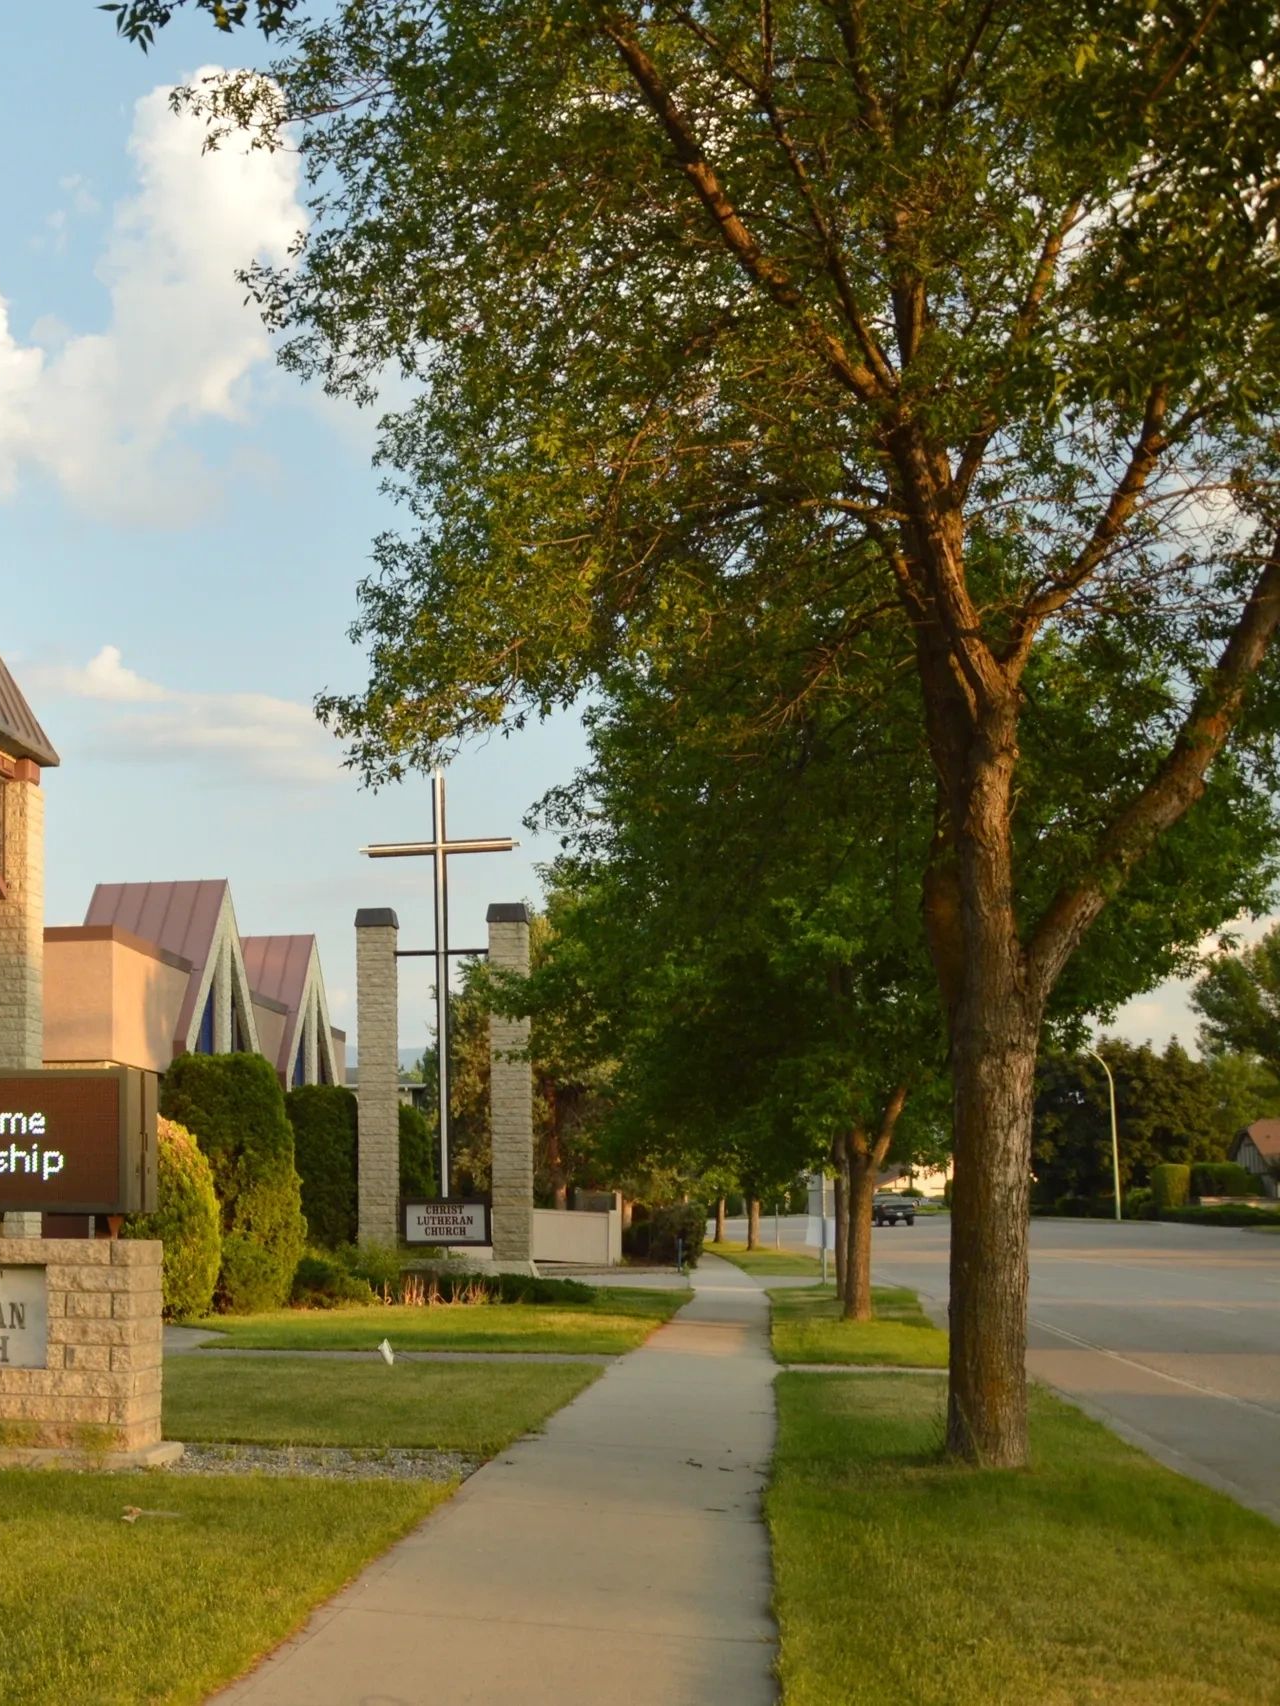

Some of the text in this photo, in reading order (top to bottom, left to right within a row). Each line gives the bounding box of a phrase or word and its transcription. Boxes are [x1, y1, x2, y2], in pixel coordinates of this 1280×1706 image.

[425, 1204, 465, 1215] CHRIST
[417, 1215, 474, 1226] LUTHERAN
[424, 1226, 467, 1236] CHURCH
